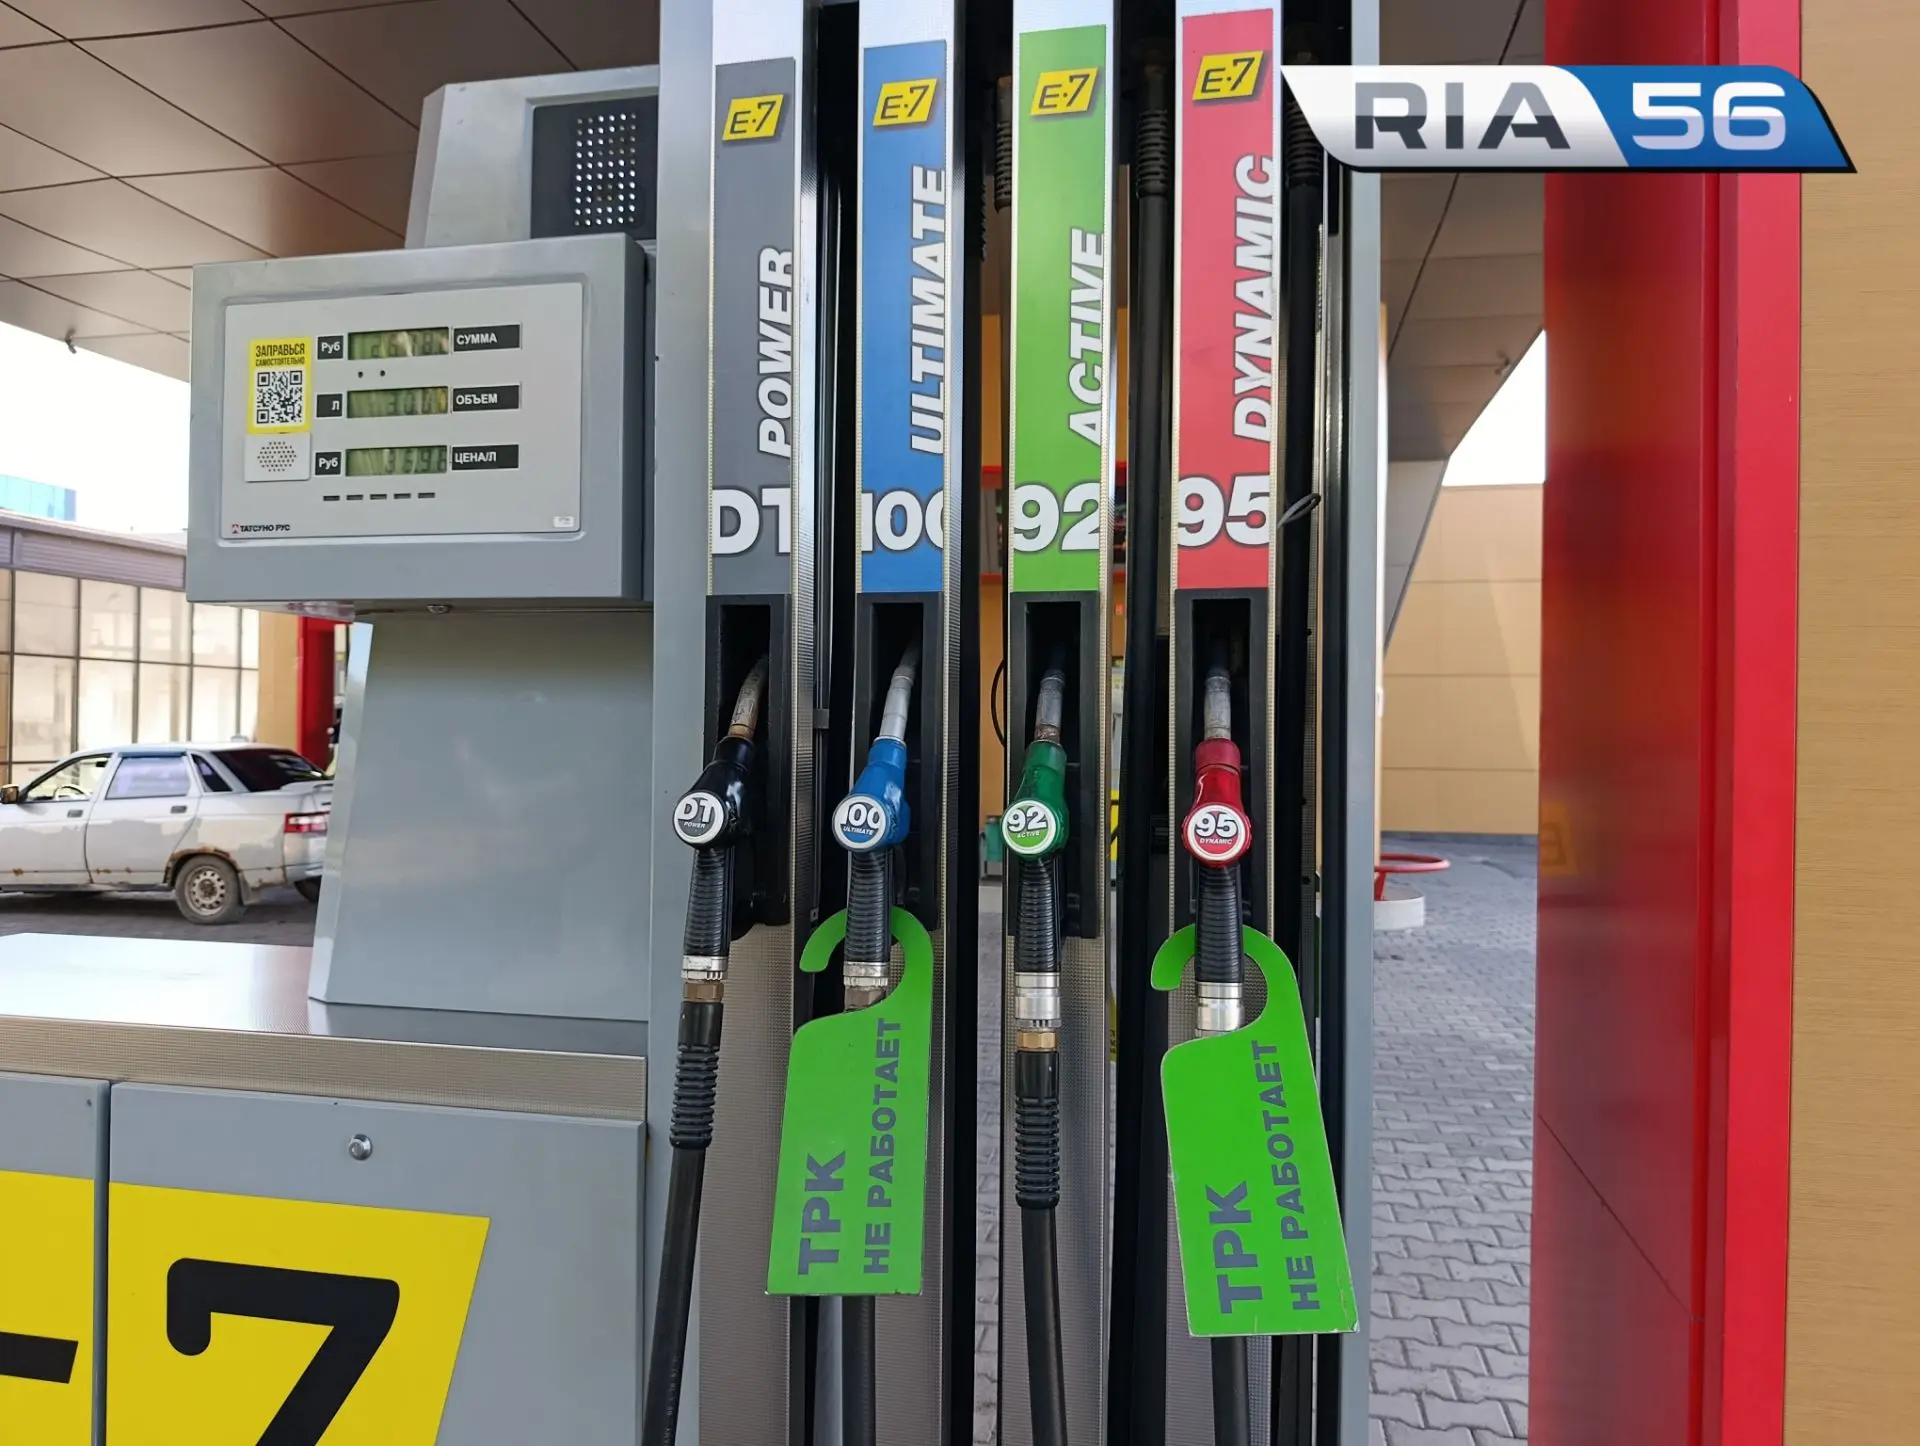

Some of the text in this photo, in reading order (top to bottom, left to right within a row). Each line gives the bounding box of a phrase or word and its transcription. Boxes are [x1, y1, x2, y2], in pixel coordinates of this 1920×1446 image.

[910, 165, 945, 455] ULTIMATE
[1233, 153, 1273, 444] DYNAMIC
[255, 343, 305, 357] ЗАПРАВЬСЯ
[321, 342, 341, 354] Руб
[456, 333, 498, 345] СУММА
[1068, 227, 1105, 448] ACTIVE
[758, 246, 793, 458] POWER
[455, 394, 498, 406] ОБЪЕМ
[318, 457, 338, 469] Руб
[455, 452, 497, 464] ЦЕНА/Л
[1013, 483, 1100, 552] 92
[1176, 476, 1272, 548] 95
[684, 821, 706, 829] POWER
[843, 826, 874, 836] ULTIMATE
[1007, 805, 1048, 832] 92
[1194, 812, 1238, 837] 95
[1016, 830, 1040, 838] ACTIVE
[1199, 837, 1232, 845] DYNAMIC
[863, 1017, 902, 1275] НЕ РАБОТАЕТ
[1251, 1040, 1321, 1311] НЕ РАБОТАЕТ
[798, 1149, 848, 1276] ТРК
[1205, 1180, 1263, 1315] ТРК
